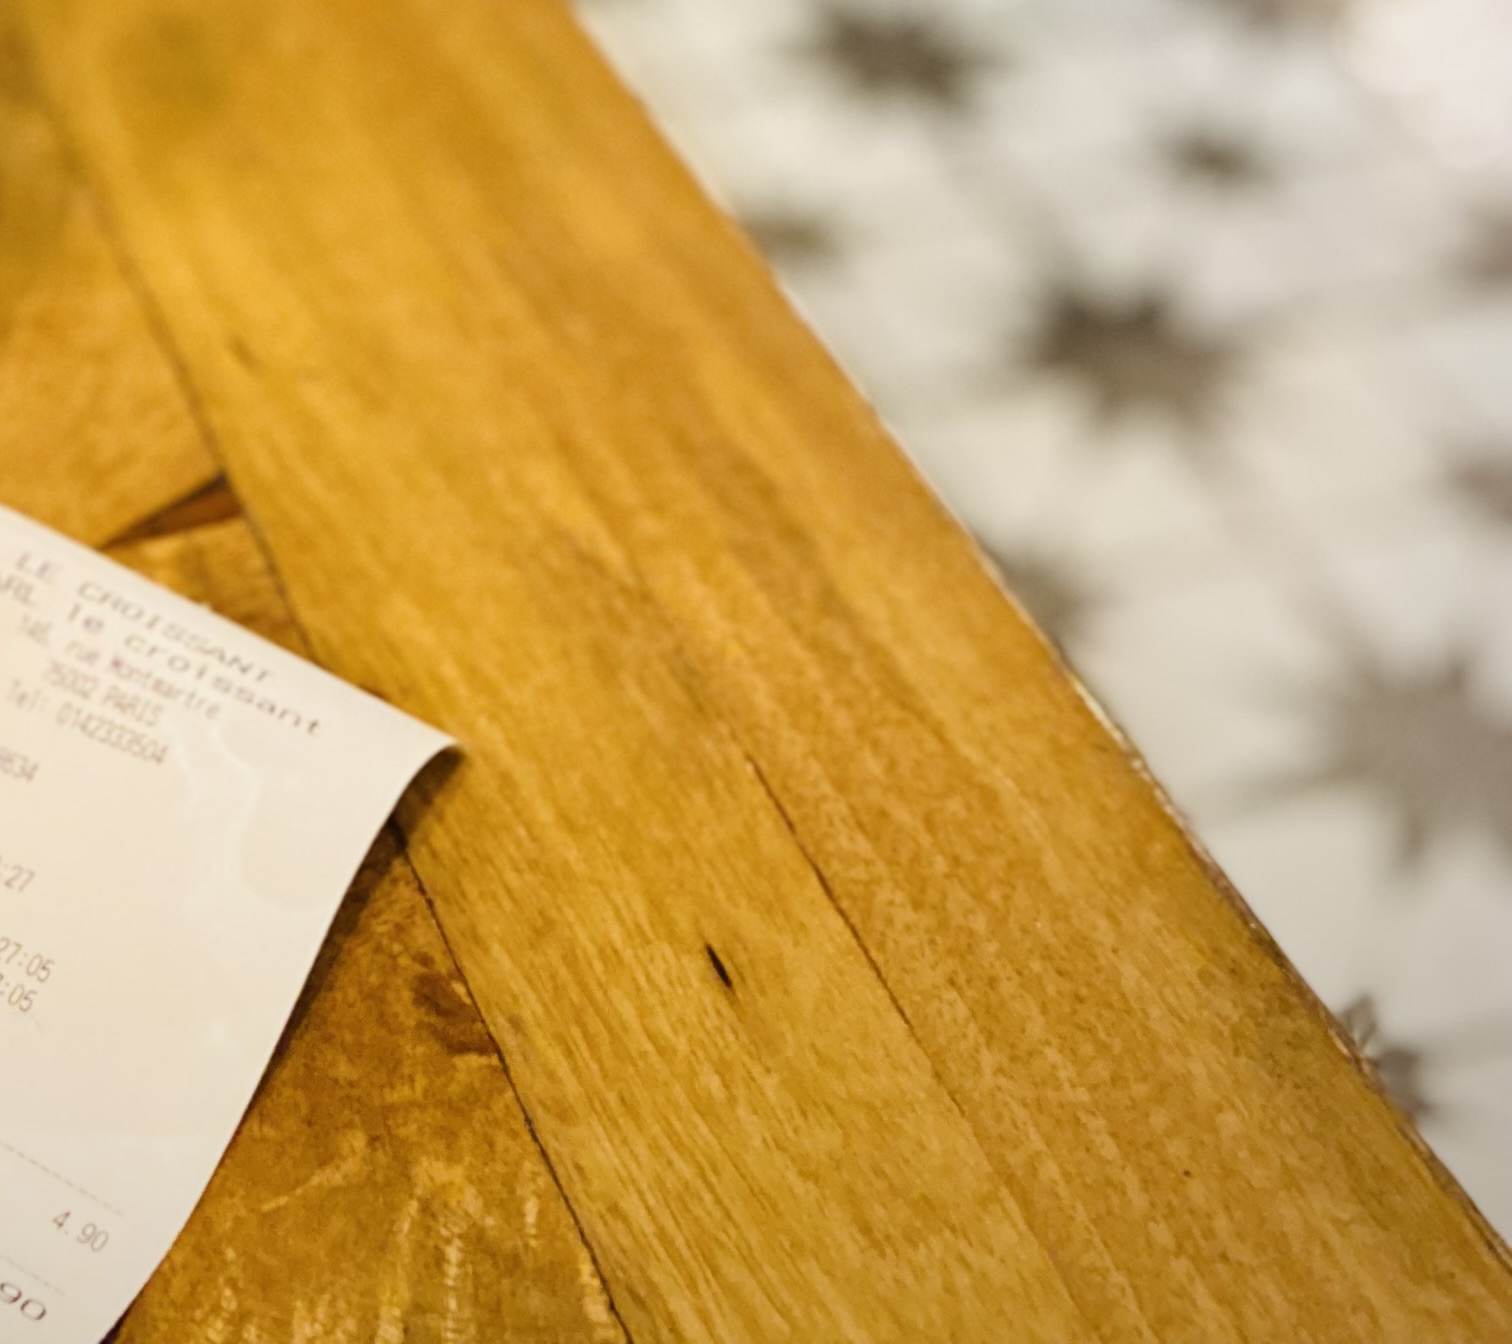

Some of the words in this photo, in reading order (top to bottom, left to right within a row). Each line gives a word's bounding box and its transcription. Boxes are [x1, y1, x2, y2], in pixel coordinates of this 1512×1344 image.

[16, 551, 59, 582] LE
[77, 579, 277, 684] CROISSANT
[67, 603, 104, 633] le
[124, 633, 321, 736] croissant
[100, 684, 165, 727] PARIS
[50, 1209, 110, 1253] 4.90
